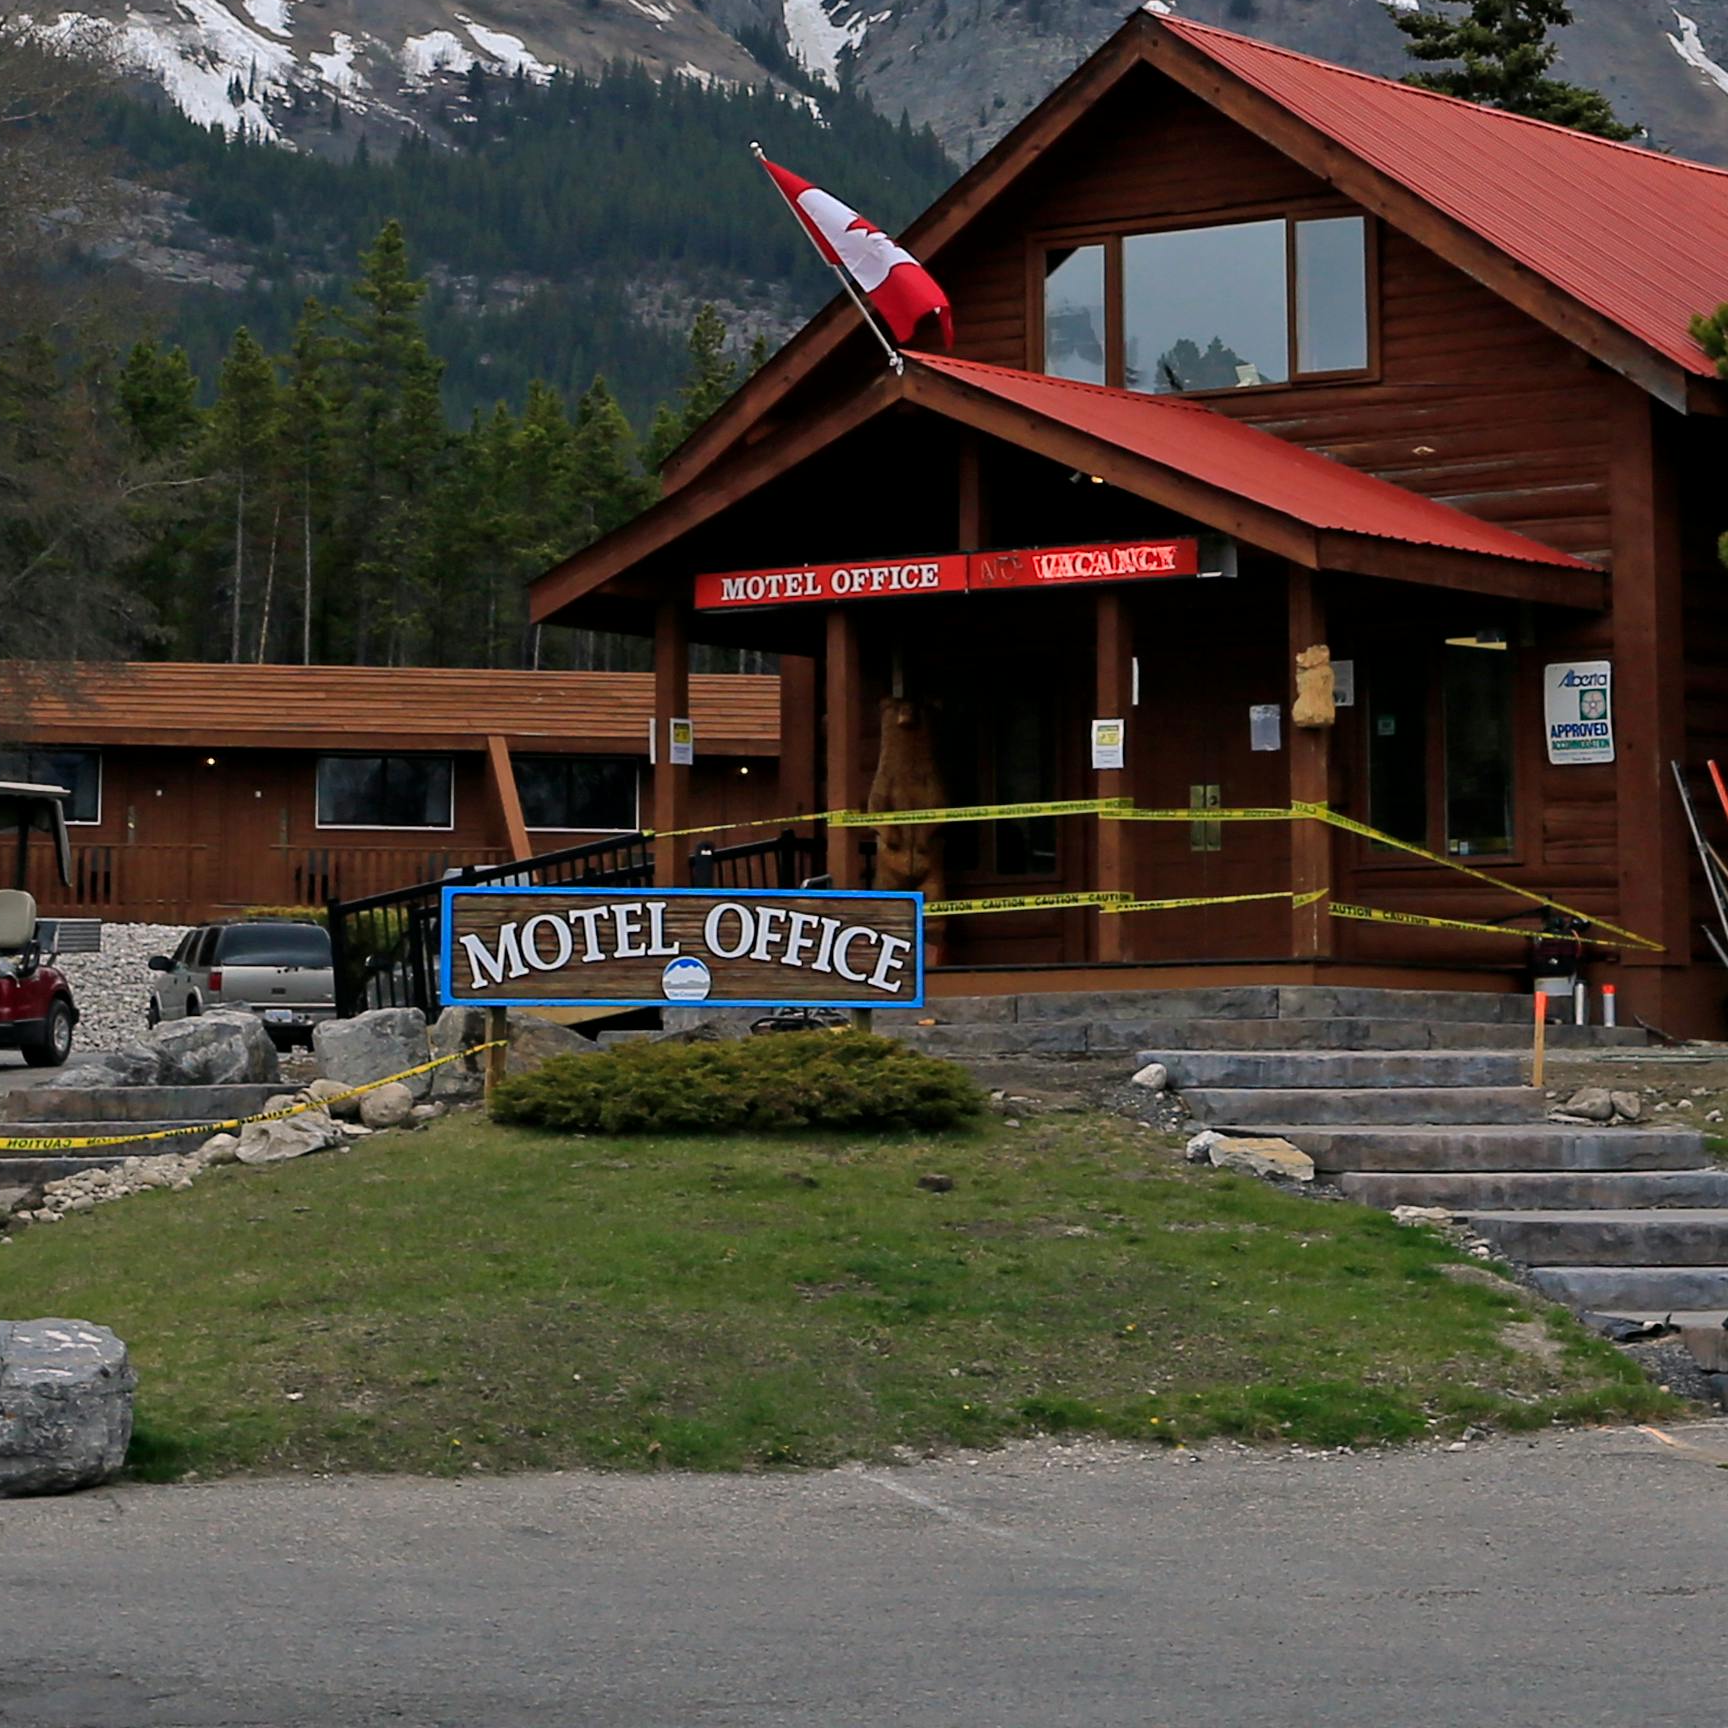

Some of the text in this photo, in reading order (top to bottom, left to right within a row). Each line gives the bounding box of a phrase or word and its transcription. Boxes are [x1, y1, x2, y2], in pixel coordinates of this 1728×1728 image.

[1032, 545, 1178, 580] VACANCY
[721, 562, 940, 602] MOTEL OFFICE
[1558, 669, 1608, 688] Alberta
[1550, 722, 1609, 739] APPROVED
[929, 901, 973, 913] CAUTION
[981, 898, 1025, 910] CAUTION
[1035, 894, 1080, 906] CAUTION
[458, 901, 912, 993] MOTEL OFFICE
